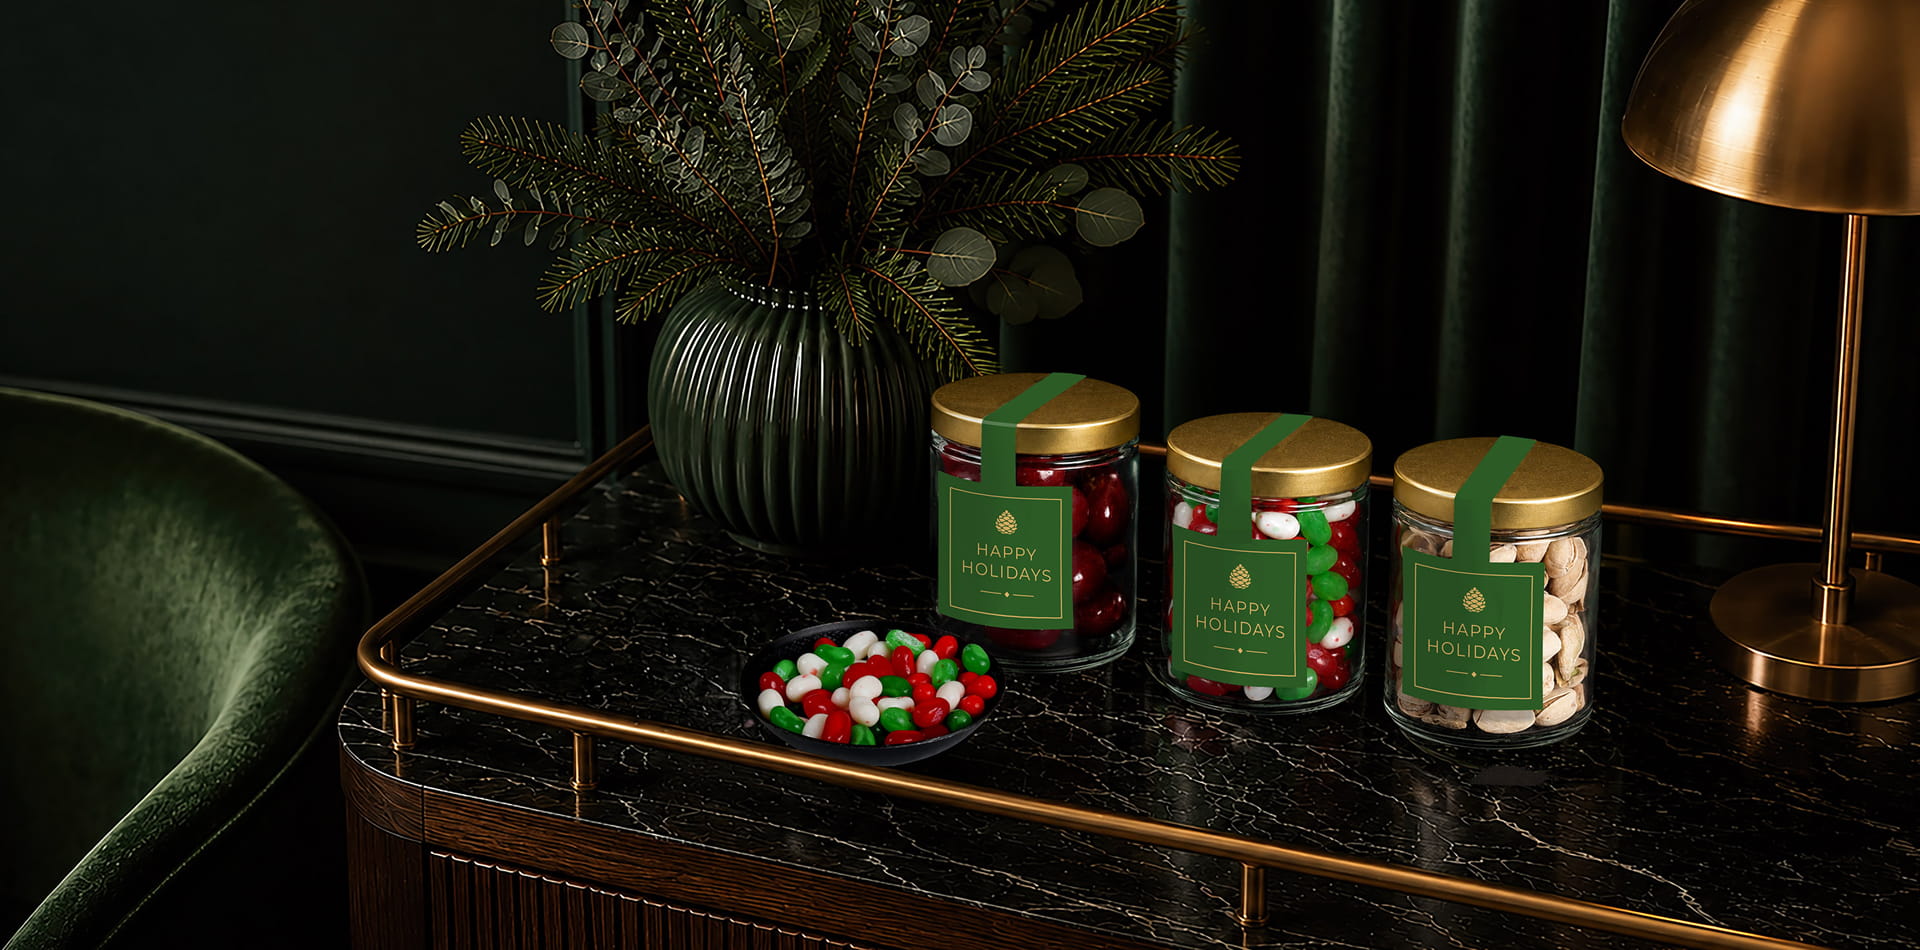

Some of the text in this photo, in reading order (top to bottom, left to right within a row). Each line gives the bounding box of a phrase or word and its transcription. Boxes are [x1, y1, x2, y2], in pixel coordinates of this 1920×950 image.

[976, 542, 1037, 561] HAPPY
[961, 559, 1052, 583] HOLIDAYS
[1210, 597, 1271, 617] HAPPY
[1195, 615, 1286, 639] HOLIDAYS
[1442, 620, 1506, 640] HAPPY
[1427, 638, 1522, 662] HOLIDAYS
